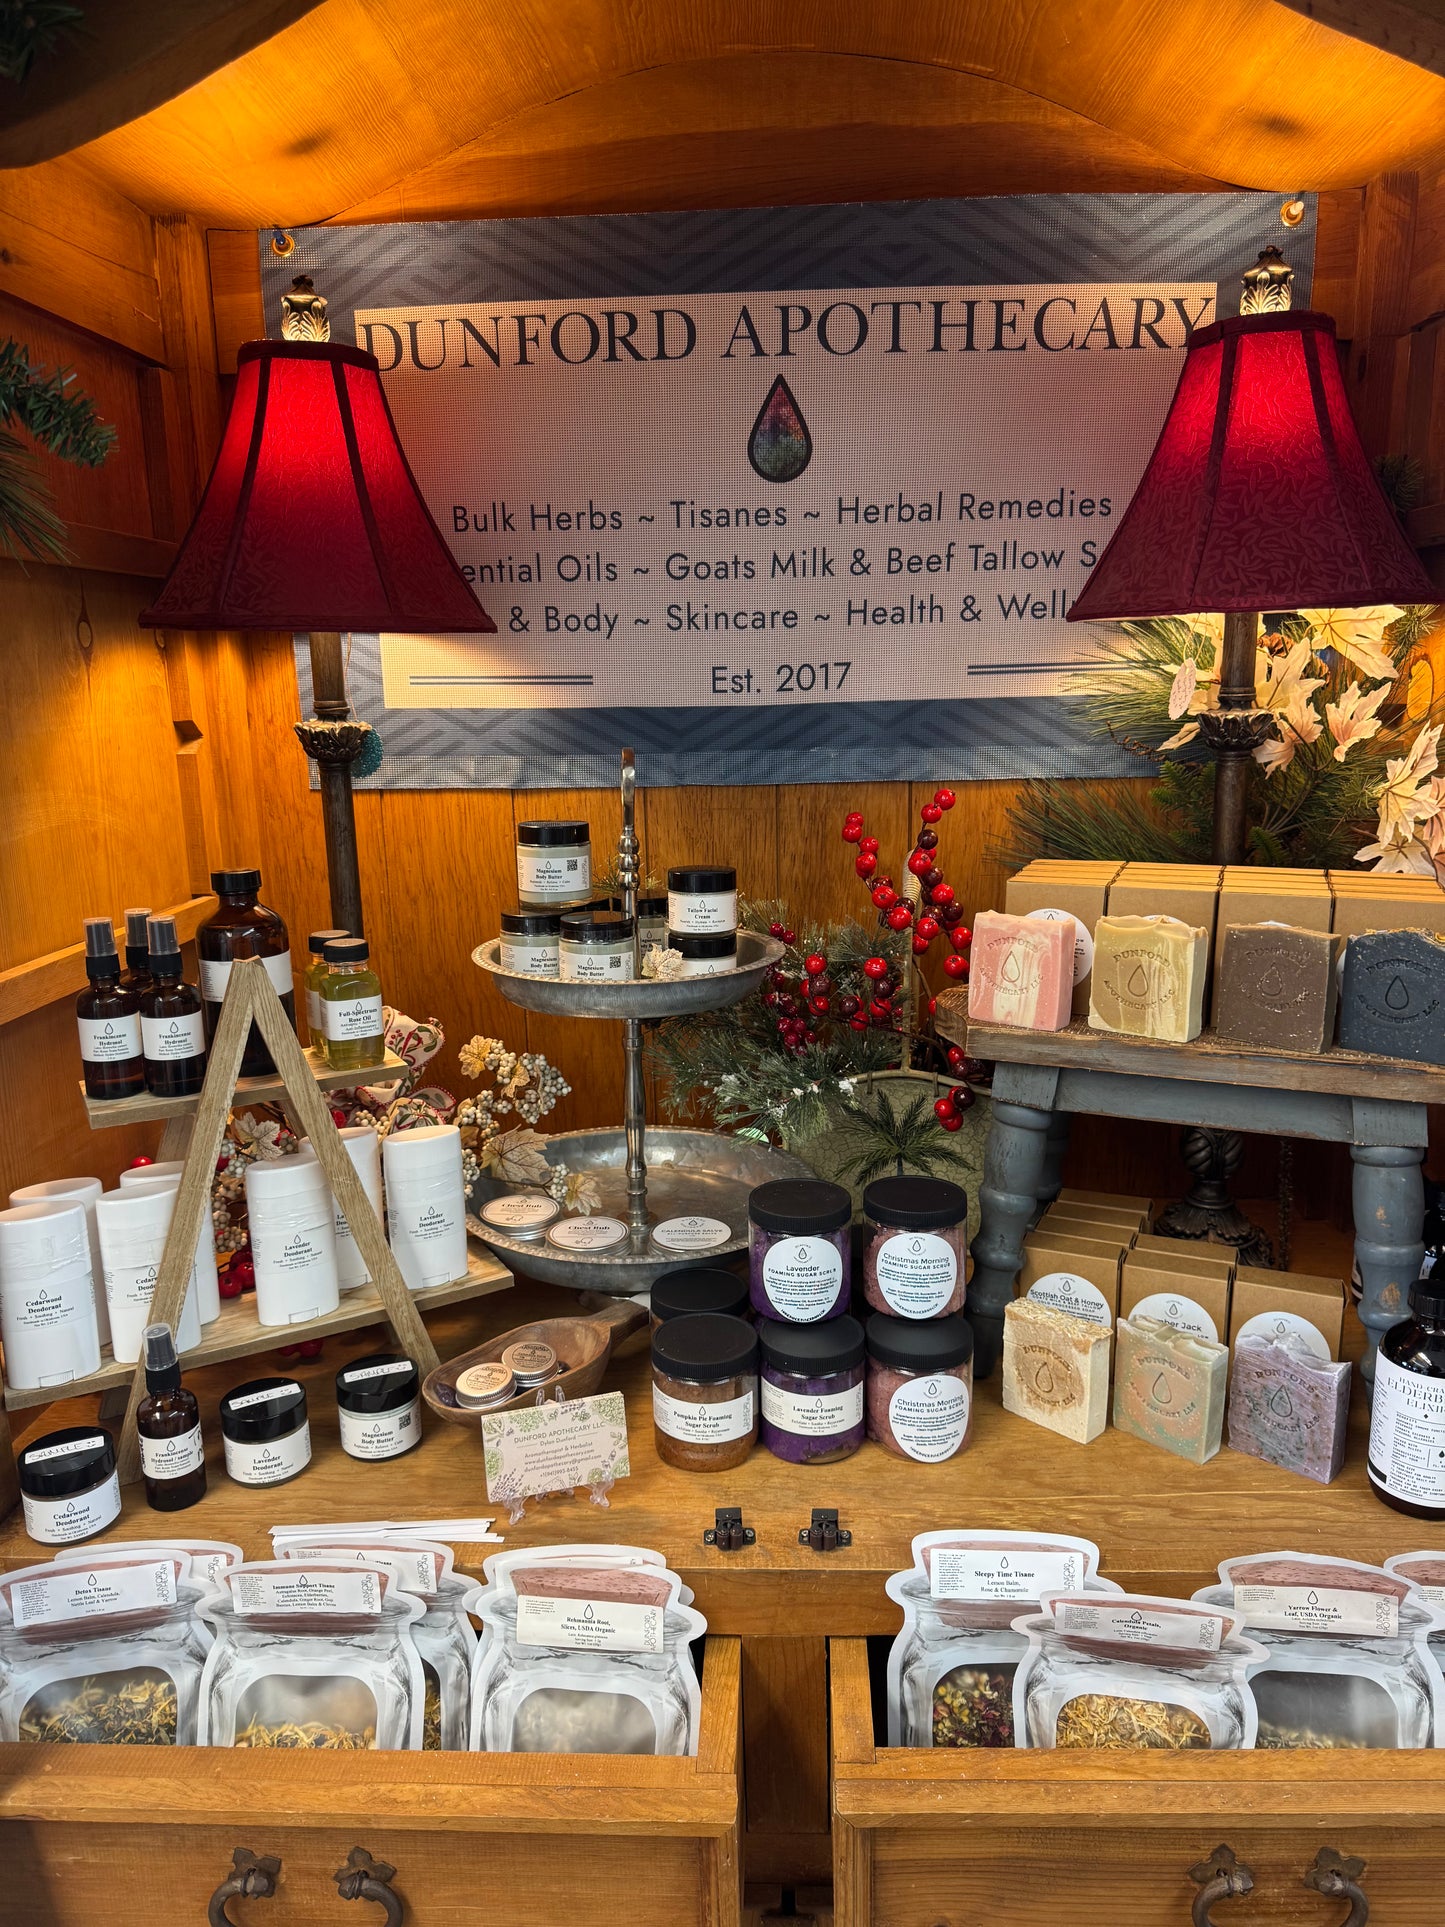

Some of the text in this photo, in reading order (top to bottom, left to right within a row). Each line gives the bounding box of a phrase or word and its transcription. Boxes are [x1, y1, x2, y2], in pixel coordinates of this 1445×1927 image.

[358, 297, 1214, 372] DUNFORD APOTHECARY
[453, 501, 516, 533] Bulk
[530, 499, 623, 532] Herbs
[670, 500, 787, 528] Tisanes
[838, 491, 943, 524] Herbal
[957, 488, 1112, 520] Remedies
[463, 552, 542, 584] ential
[557, 551, 618, 583] Oils
[666, 552, 756, 581] Goats
[770, 547, 835, 578] Milk
[850, 548, 872, 576] &
[887, 542, 956, 575] Beef
[968, 540, 1066, 572] Tallow
[508, 606, 531, 633] &
[545, 603, 619, 640] Body
[666, 600, 798, 632] Skincare
[847, 594, 944, 626] Health
[960, 595, 983, 622] &
[997, 589, 1075, 620] Well
[711, 661, 852, 693] Est. 2017
[1113, 949, 1171, 967] DUNFORD
[158, 1031, 191, 1039] Frankincense
[419, 1213, 443, 1221] Lavender
[419, 1218, 446, 1228] Deodorant
[285, 1242, 311, 1250] Lavender
[284, 1247, 313, 1257] Deodorant
[881, 1259, 909, 1268] FOAMING
[883, 1252, 919, 1264] Christmas
[768, 1268, 795, 1277] FOAMING
[26, 1295, 62, 1307] Cedarwood
[1030, 1289, 1058, 1299] Scottish
[1059, 1295, 1073, 1303] Oat
[1081, 1298, 1104, 1309] Honey
[28, 1303, 62, 1314] Deodorant
[1158, 1318, 1202, 1332] mber Jack
[1387, 1377, 1445, 1404] ELDERB
[1399, 1377, 1445, 1395] HAND CRA
[897, 1394, 964, 1408] Christmas Morning
[793, 1405, 843, 1413] Lavender Foaming
[895, 1405, 924, 1413] FOAMING
[673, 1411, 697, 1421] Pumpkin
[685, 1421, 701, 1429] Sugar
[514, 1433, 547, 1443] DUNFORD
[548, 1424, 591, 1437] APOTHECARY
[555, 1435, 577, 1443] Dunford
[155, 1447, 188, 1457] Frankincense
[253, 1455, 281, 1464] Lavender
[252, 1461, 283, 1471] Deodorant
[53, 1506, 90, 1520] Cedarwood
[56, 1515, 90, 1527] Deodorant
[566, 1616, 596, 1624] Rehmannia
